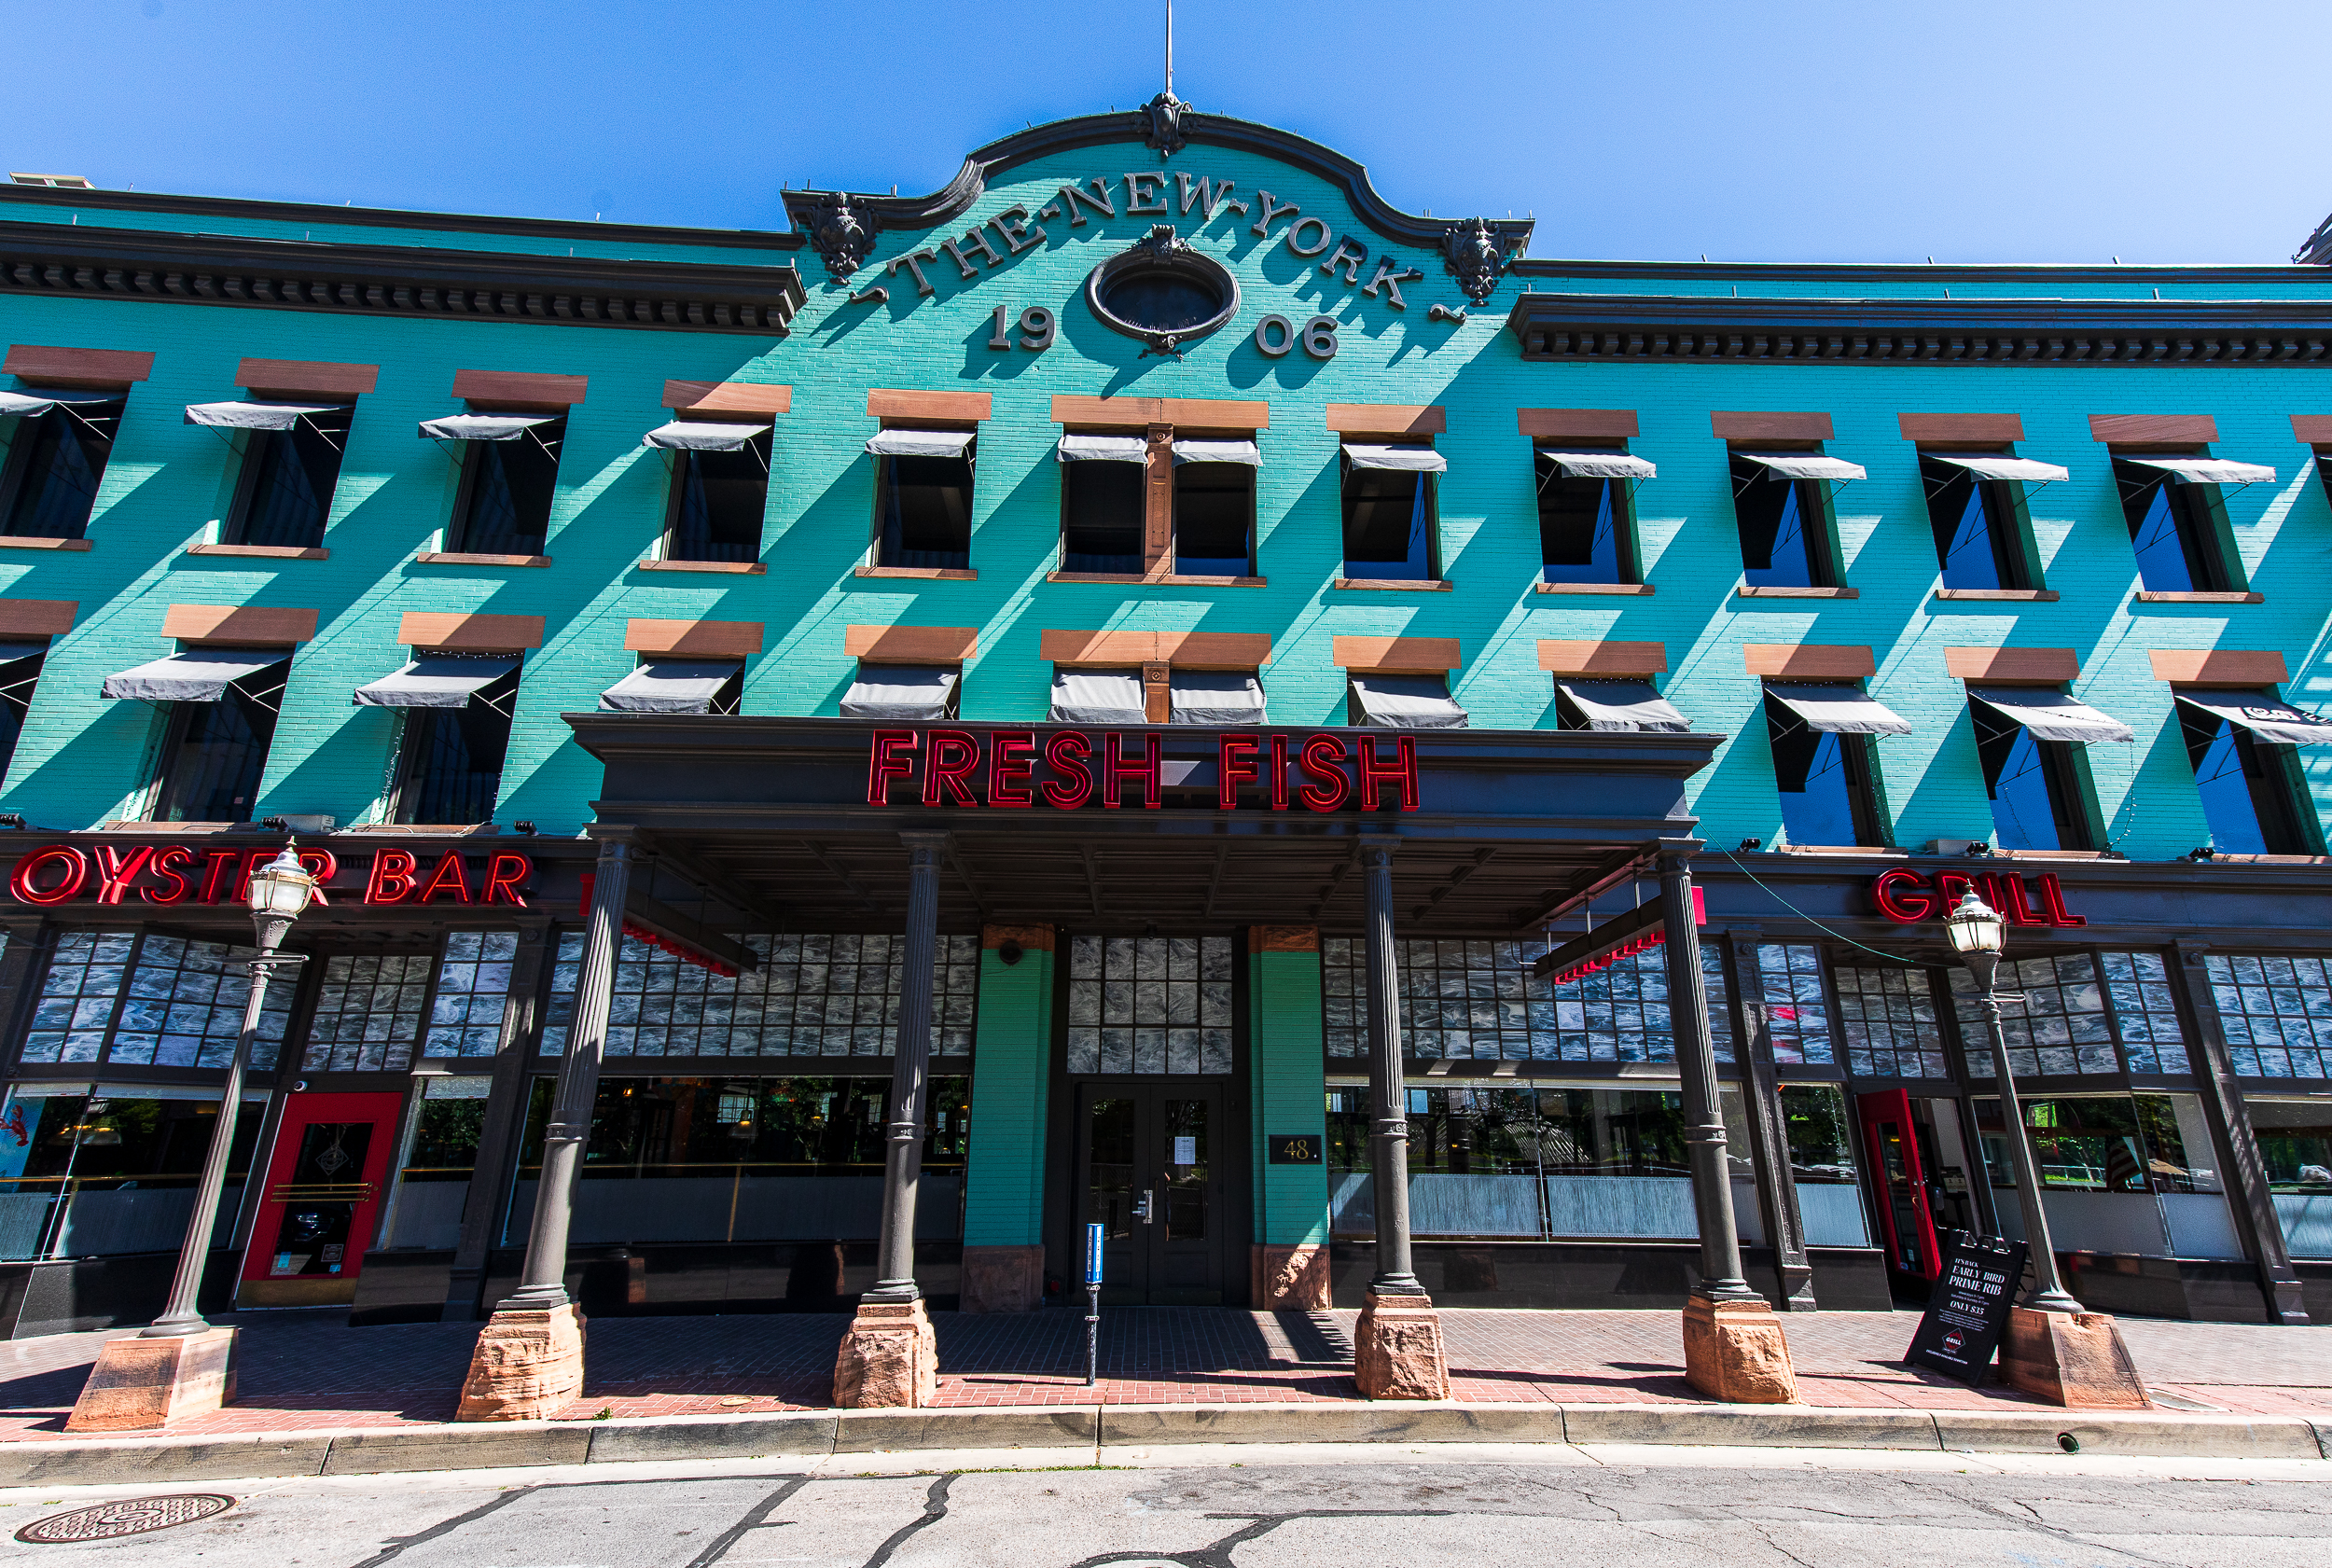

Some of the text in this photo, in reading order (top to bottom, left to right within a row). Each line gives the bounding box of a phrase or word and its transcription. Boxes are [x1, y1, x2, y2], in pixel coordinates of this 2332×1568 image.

[868, 728, 1421, 812] FRESH FISH
[364, 848, 534, 908] BAR
[1871, 867, 2088, 928] GRILL
[1284, 1140, 1309, 1159] 48
[1951, 1265, 2006, 1284] EARLY BIRD
[1949, 1274, 2002, 1296] PRIME RIB
[1950, 1300, 1985, 1315] ONLY $35
[1946, 1337, 1962, 1346] GRILL
